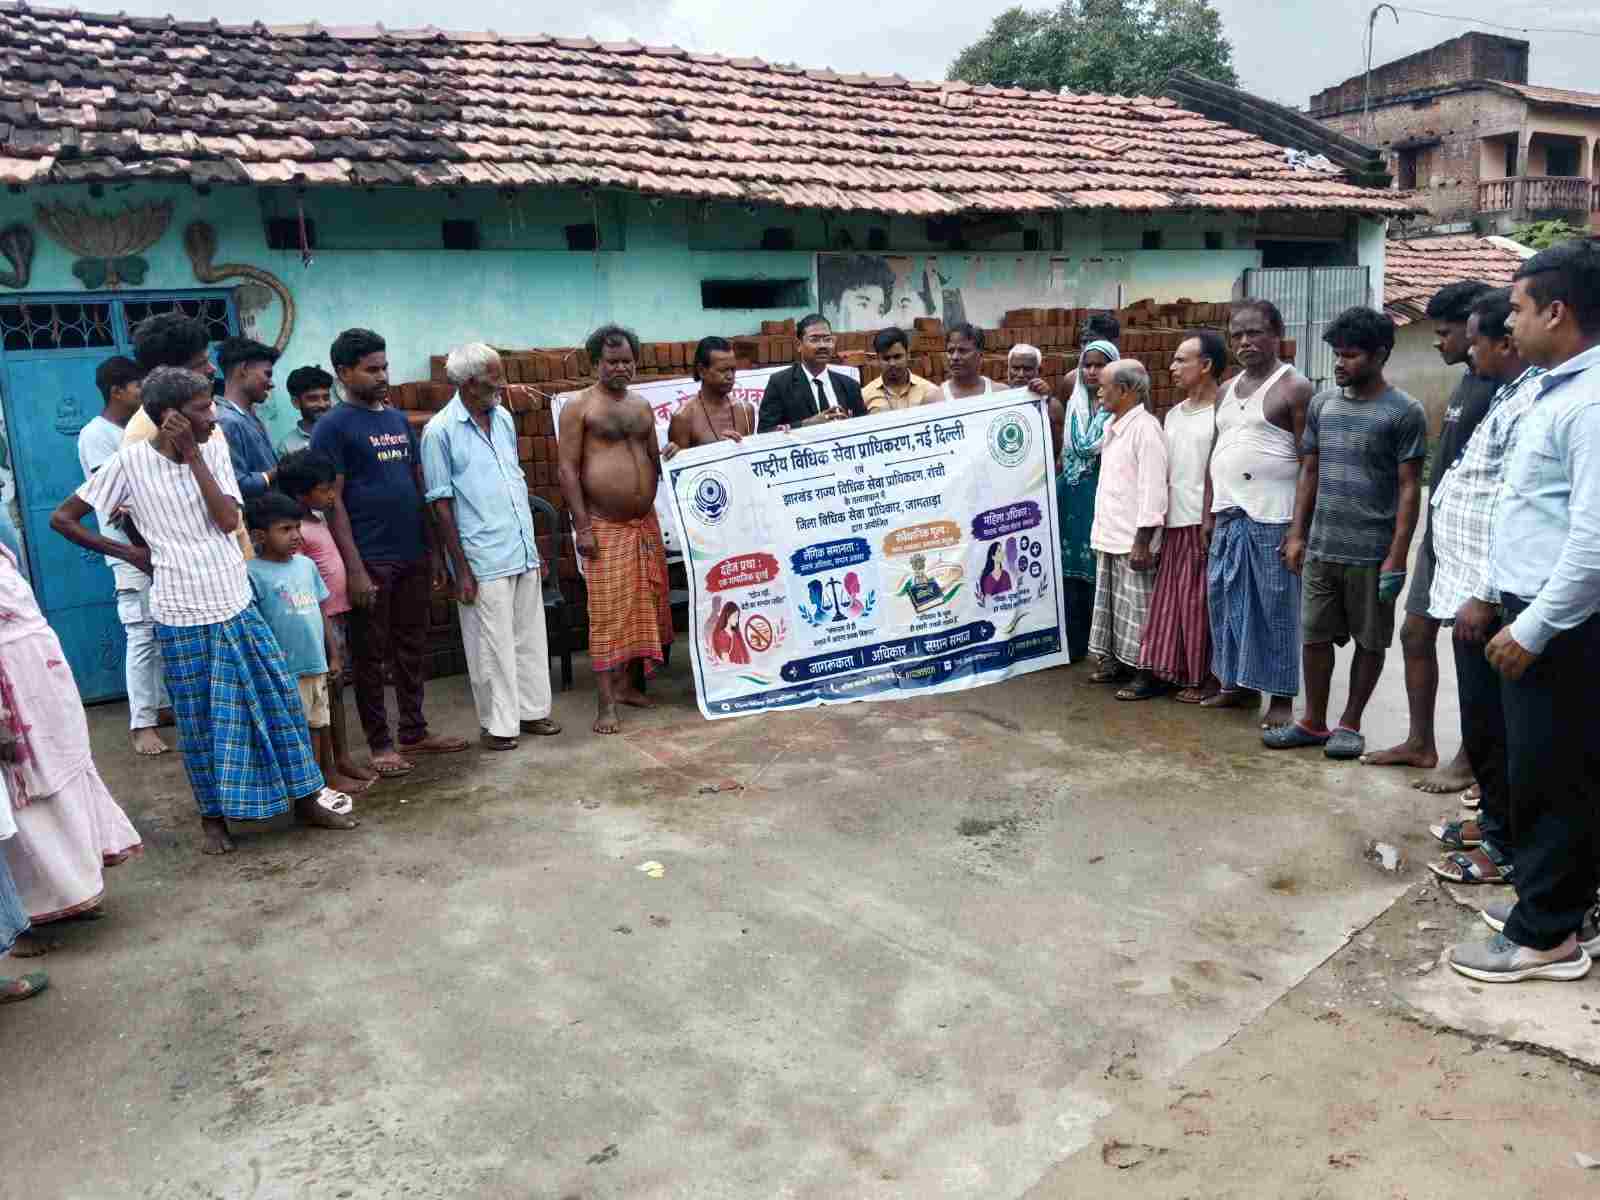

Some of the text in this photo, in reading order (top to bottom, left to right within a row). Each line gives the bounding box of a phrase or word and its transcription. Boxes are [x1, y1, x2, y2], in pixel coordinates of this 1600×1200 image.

[752, 419, 965, 478] राष्ट्रीय विधिक सेवा प्राधिकरण, नई दिल्ली
[783, 488, 814, 507] झारखंड
[814, 485, 836, 500] राज्य
[837, 479, 865, 496] विधिक
[866, 475, 885, 490] सेवा
[927, 462, 946, 479] रांची
[795, 516, 817, 531] जिला
[818, 509, 847, 528] विधिक
[848, 506, 866, 521] सेवा
[905, 492, 942, 513] जामताड़ा
[983, 511, 1006, 527] महिला
[870, 643, 908, 664] अधिकार
